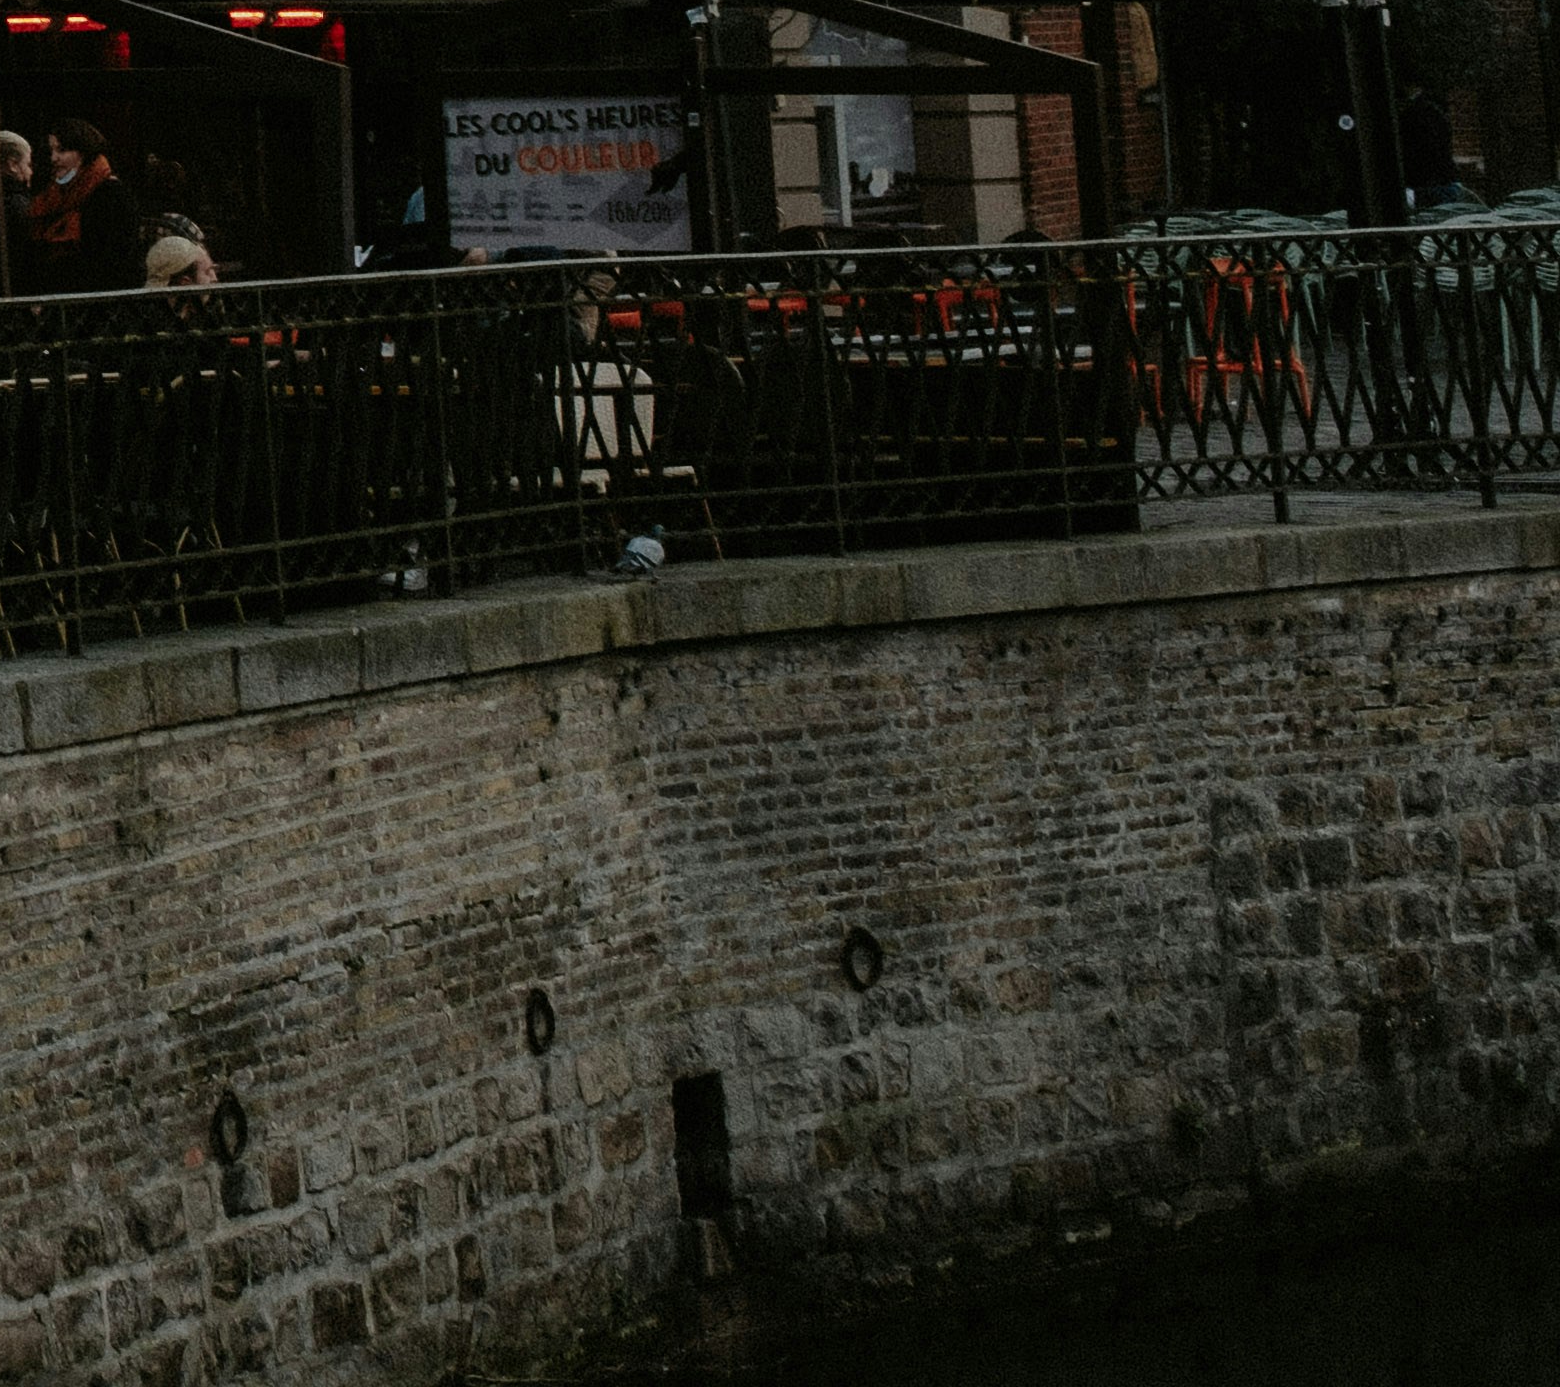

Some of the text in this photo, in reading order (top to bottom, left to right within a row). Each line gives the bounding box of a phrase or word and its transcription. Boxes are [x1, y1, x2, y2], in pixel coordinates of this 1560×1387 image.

[444, 115, 484, 138] LES
[587, 103, 686, 130] HEURES
[474, 140, 660, 176] DU COULEUR
